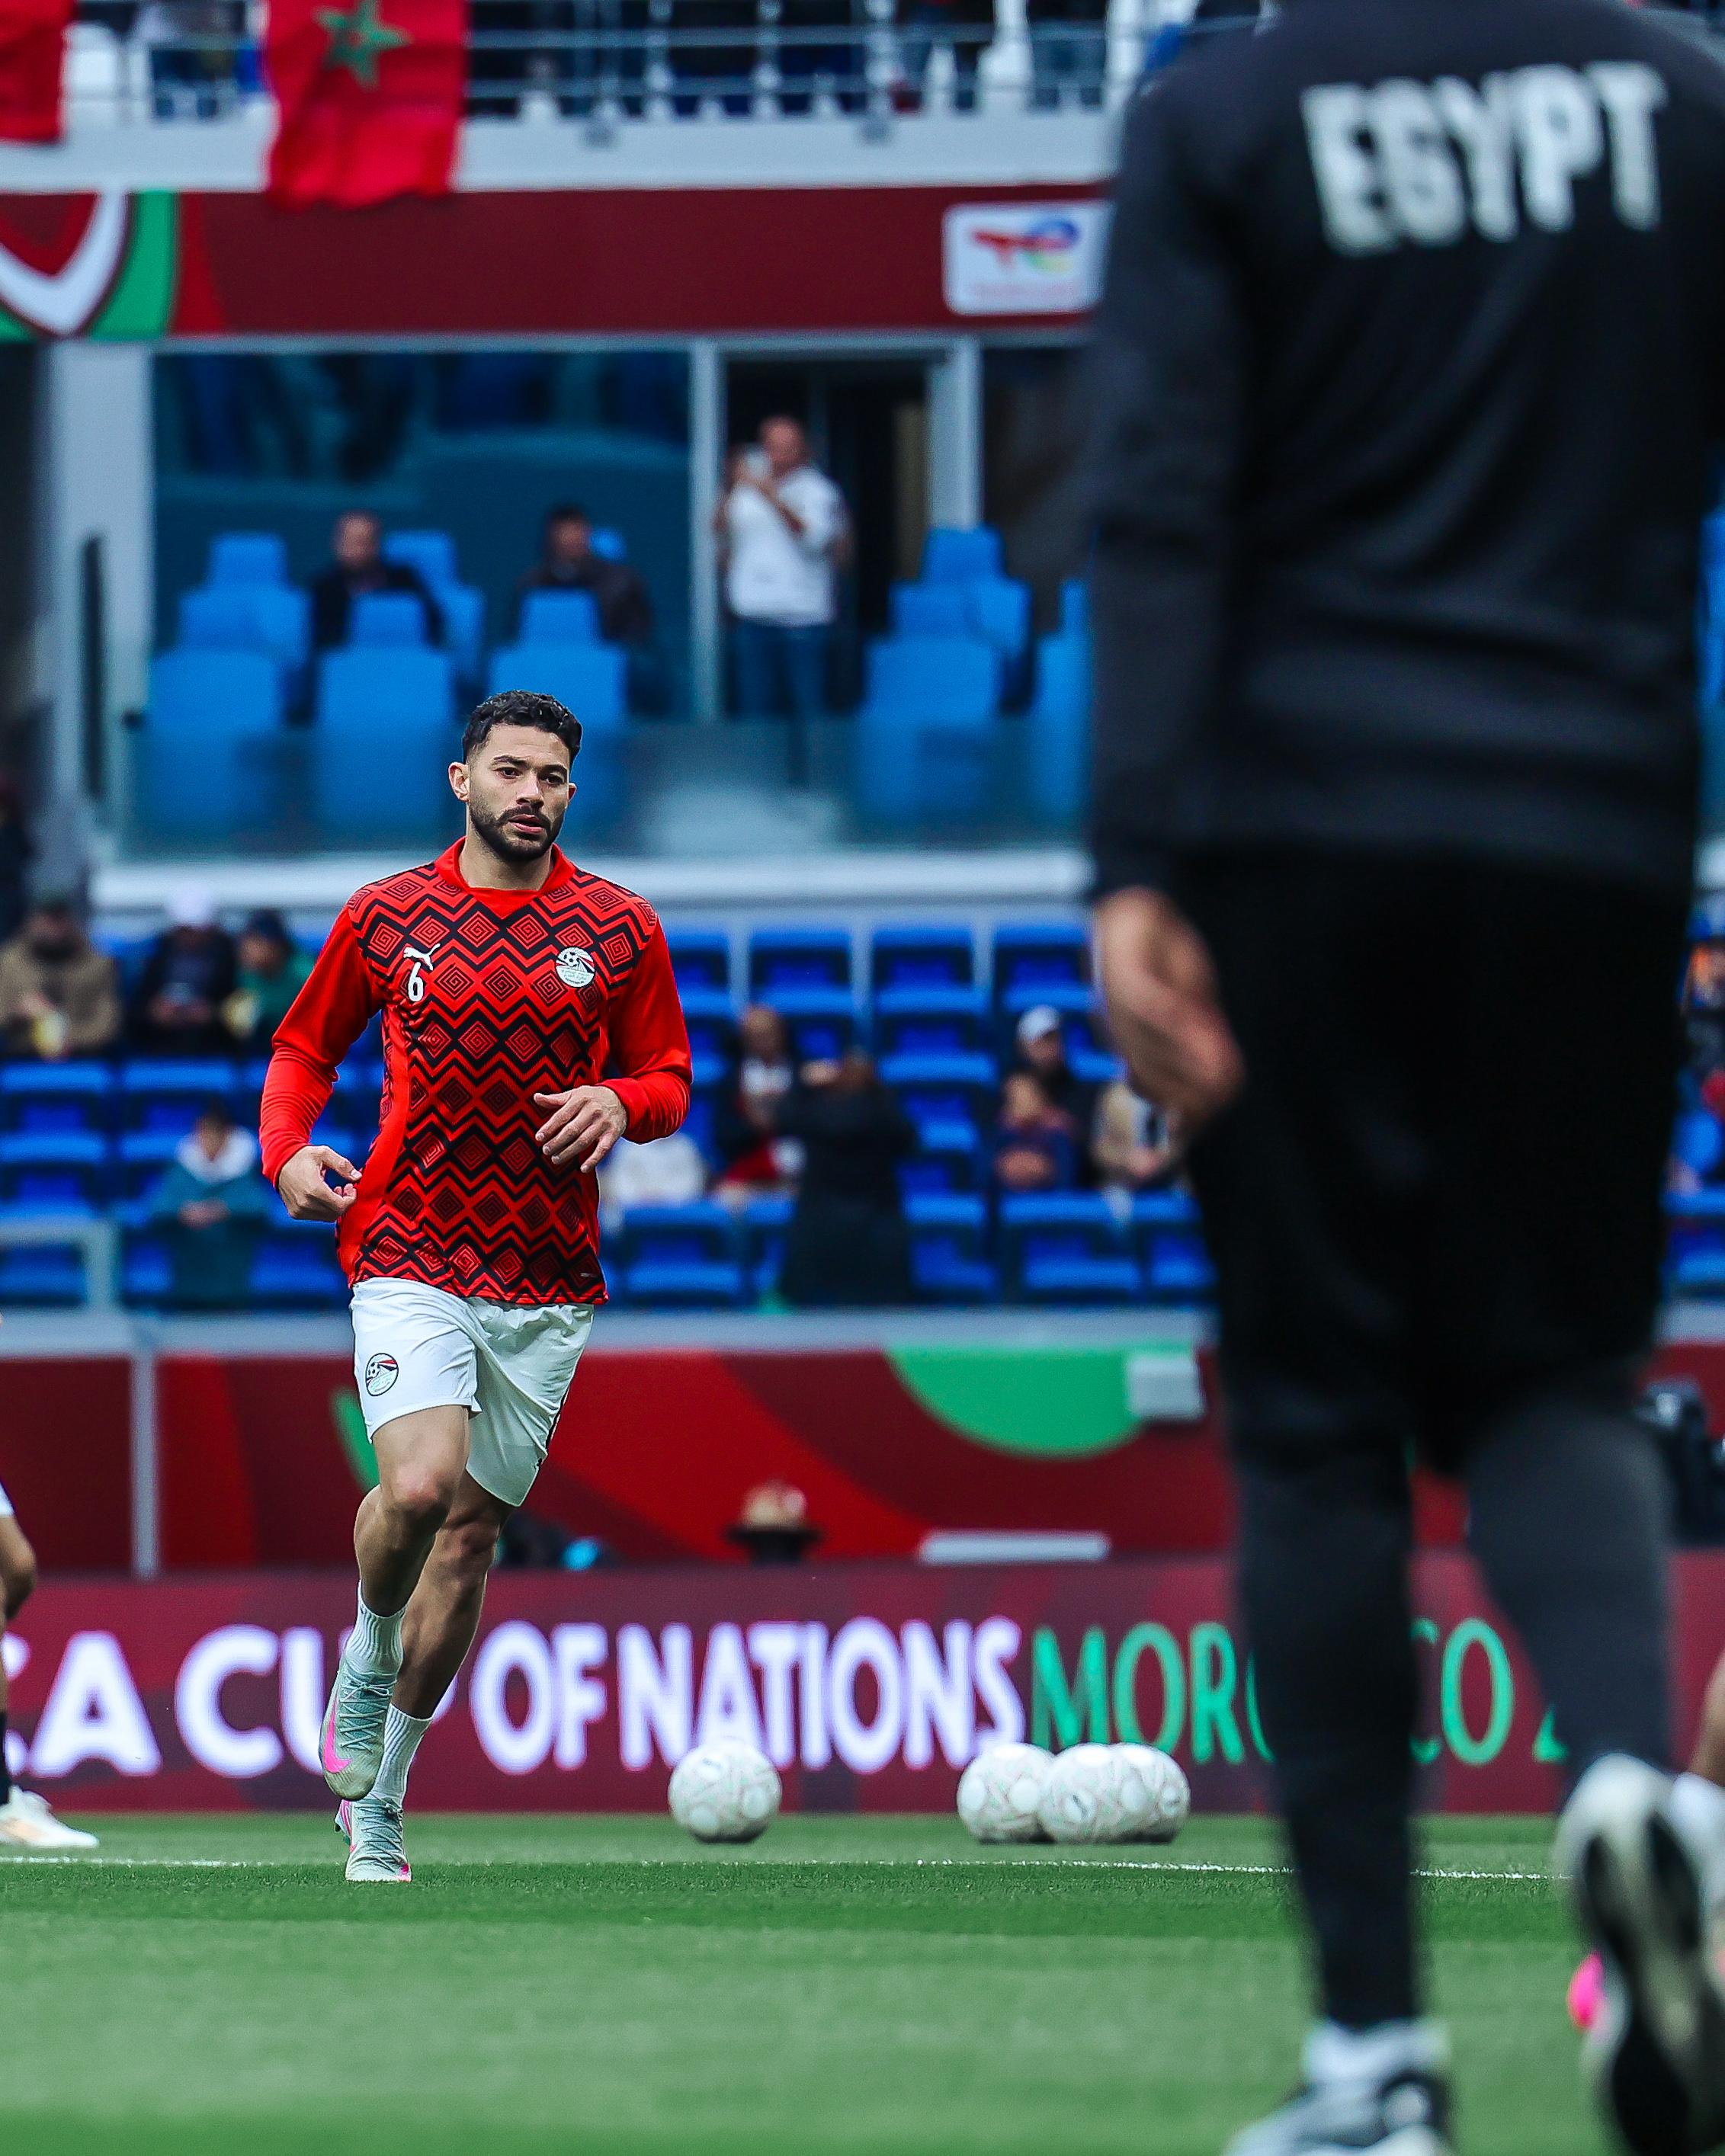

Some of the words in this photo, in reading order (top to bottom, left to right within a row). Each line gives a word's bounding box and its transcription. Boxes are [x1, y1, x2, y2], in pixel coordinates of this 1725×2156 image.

[1300, 60, 1668, 256] EGYPT
[407, 962, 424, 1002] 6
[470, 1618, 608, 1777] OF
[619, 1616, 1025, 1774] NATIONS
[1031, 1618, 1515, 1765] MORO
